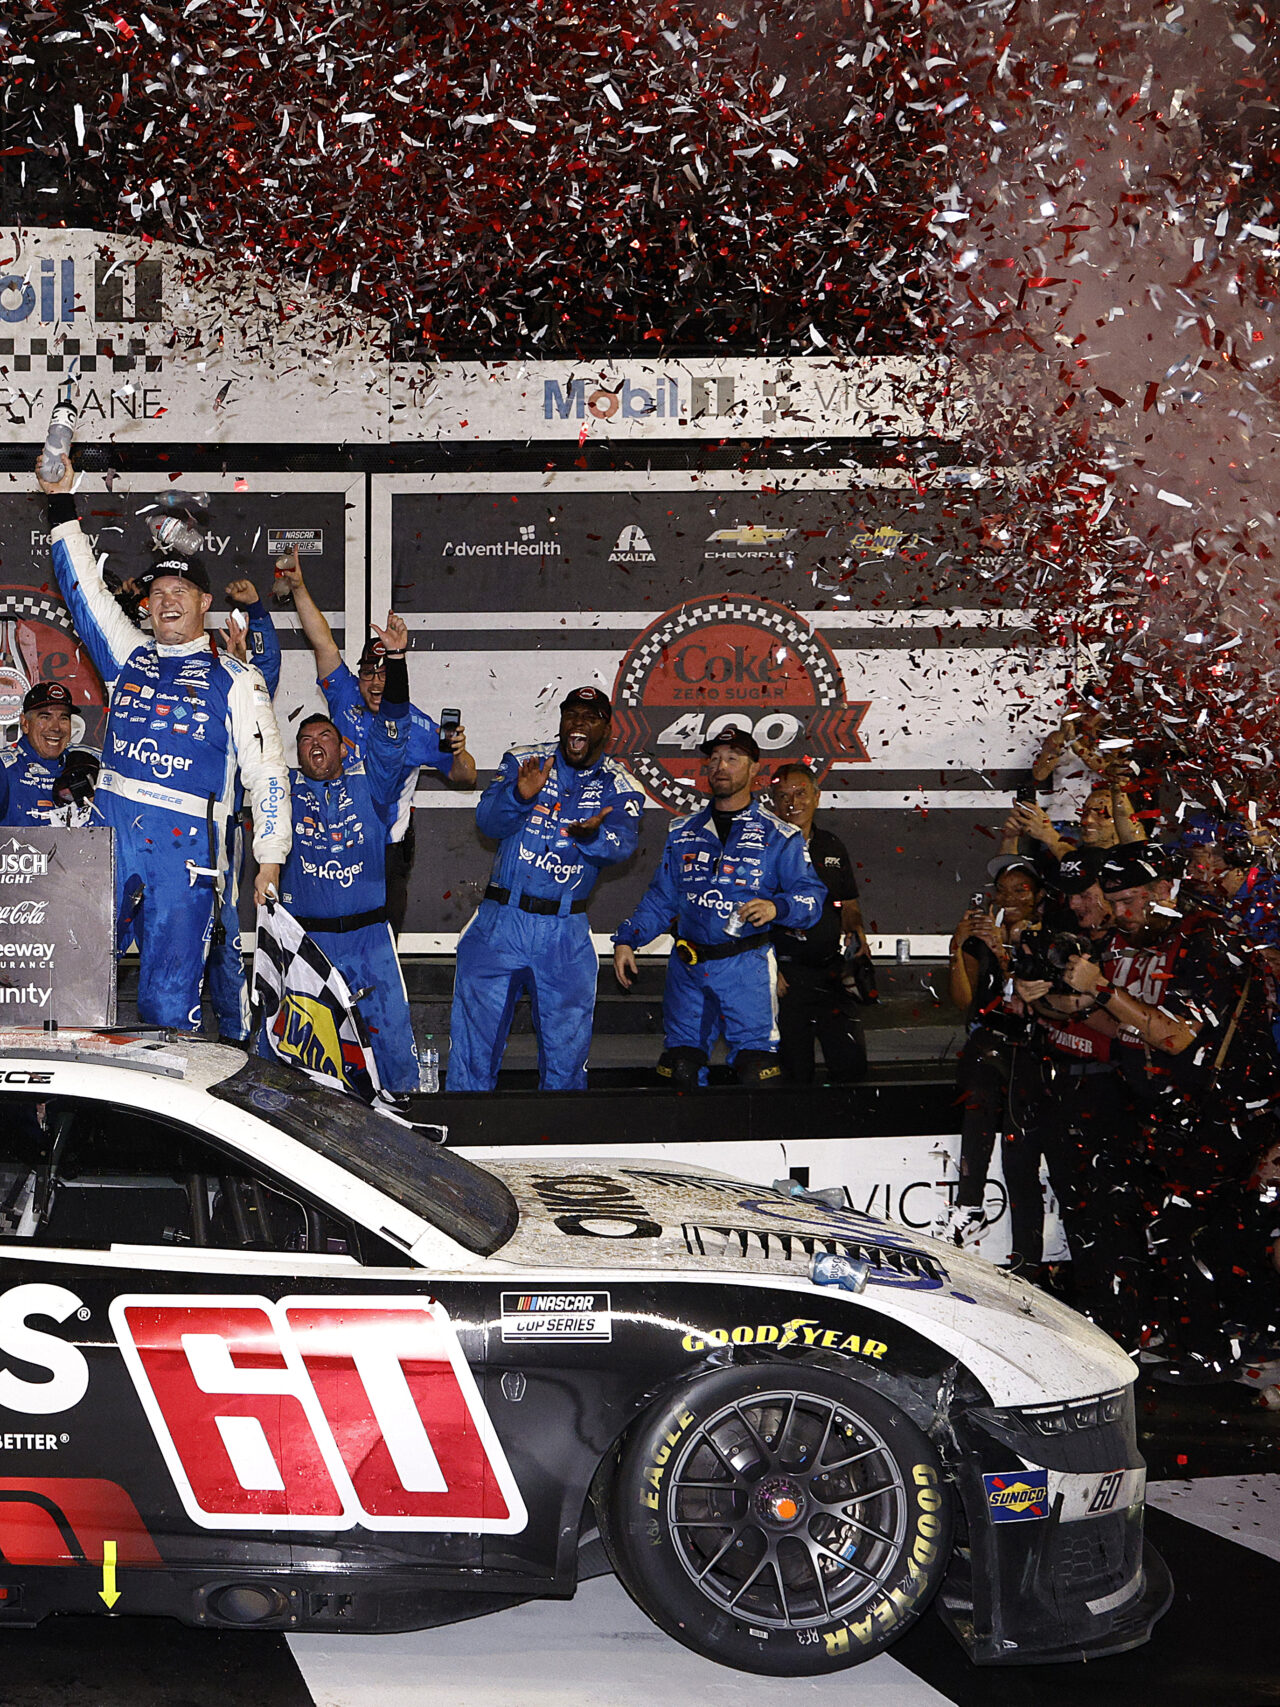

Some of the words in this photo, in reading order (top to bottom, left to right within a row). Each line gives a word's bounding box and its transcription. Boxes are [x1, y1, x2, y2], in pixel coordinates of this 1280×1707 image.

[544, 377, 679, 420] Mobil
[285, 531, 315, 539] NASCAR
[441, 541, 561, 557] AdventHealth
[608, 552, 657, 562] AXALTA
[673, 643, 786, 684] Coke
[673, 688, 723, 700] ZERO
[725, 688, 785, 700] SUGAR
[657, 713, 800, 750] 400
[128, 737, 193, 779] Kroger
[259, 776, 286, 819] Kroger
[318, 860, 364, 888] Kroger
[535, 852, 584, 884] Kroger
[536, 1295, 595, 1311] NASCAR
[549, 1317, 596, 1332] SERIES
[639, 1401, 697, 1511] EAGLE
[989, 1486, 1047, 1507] SUNOCO
[1085, 1469, 1126, 1517] 60
